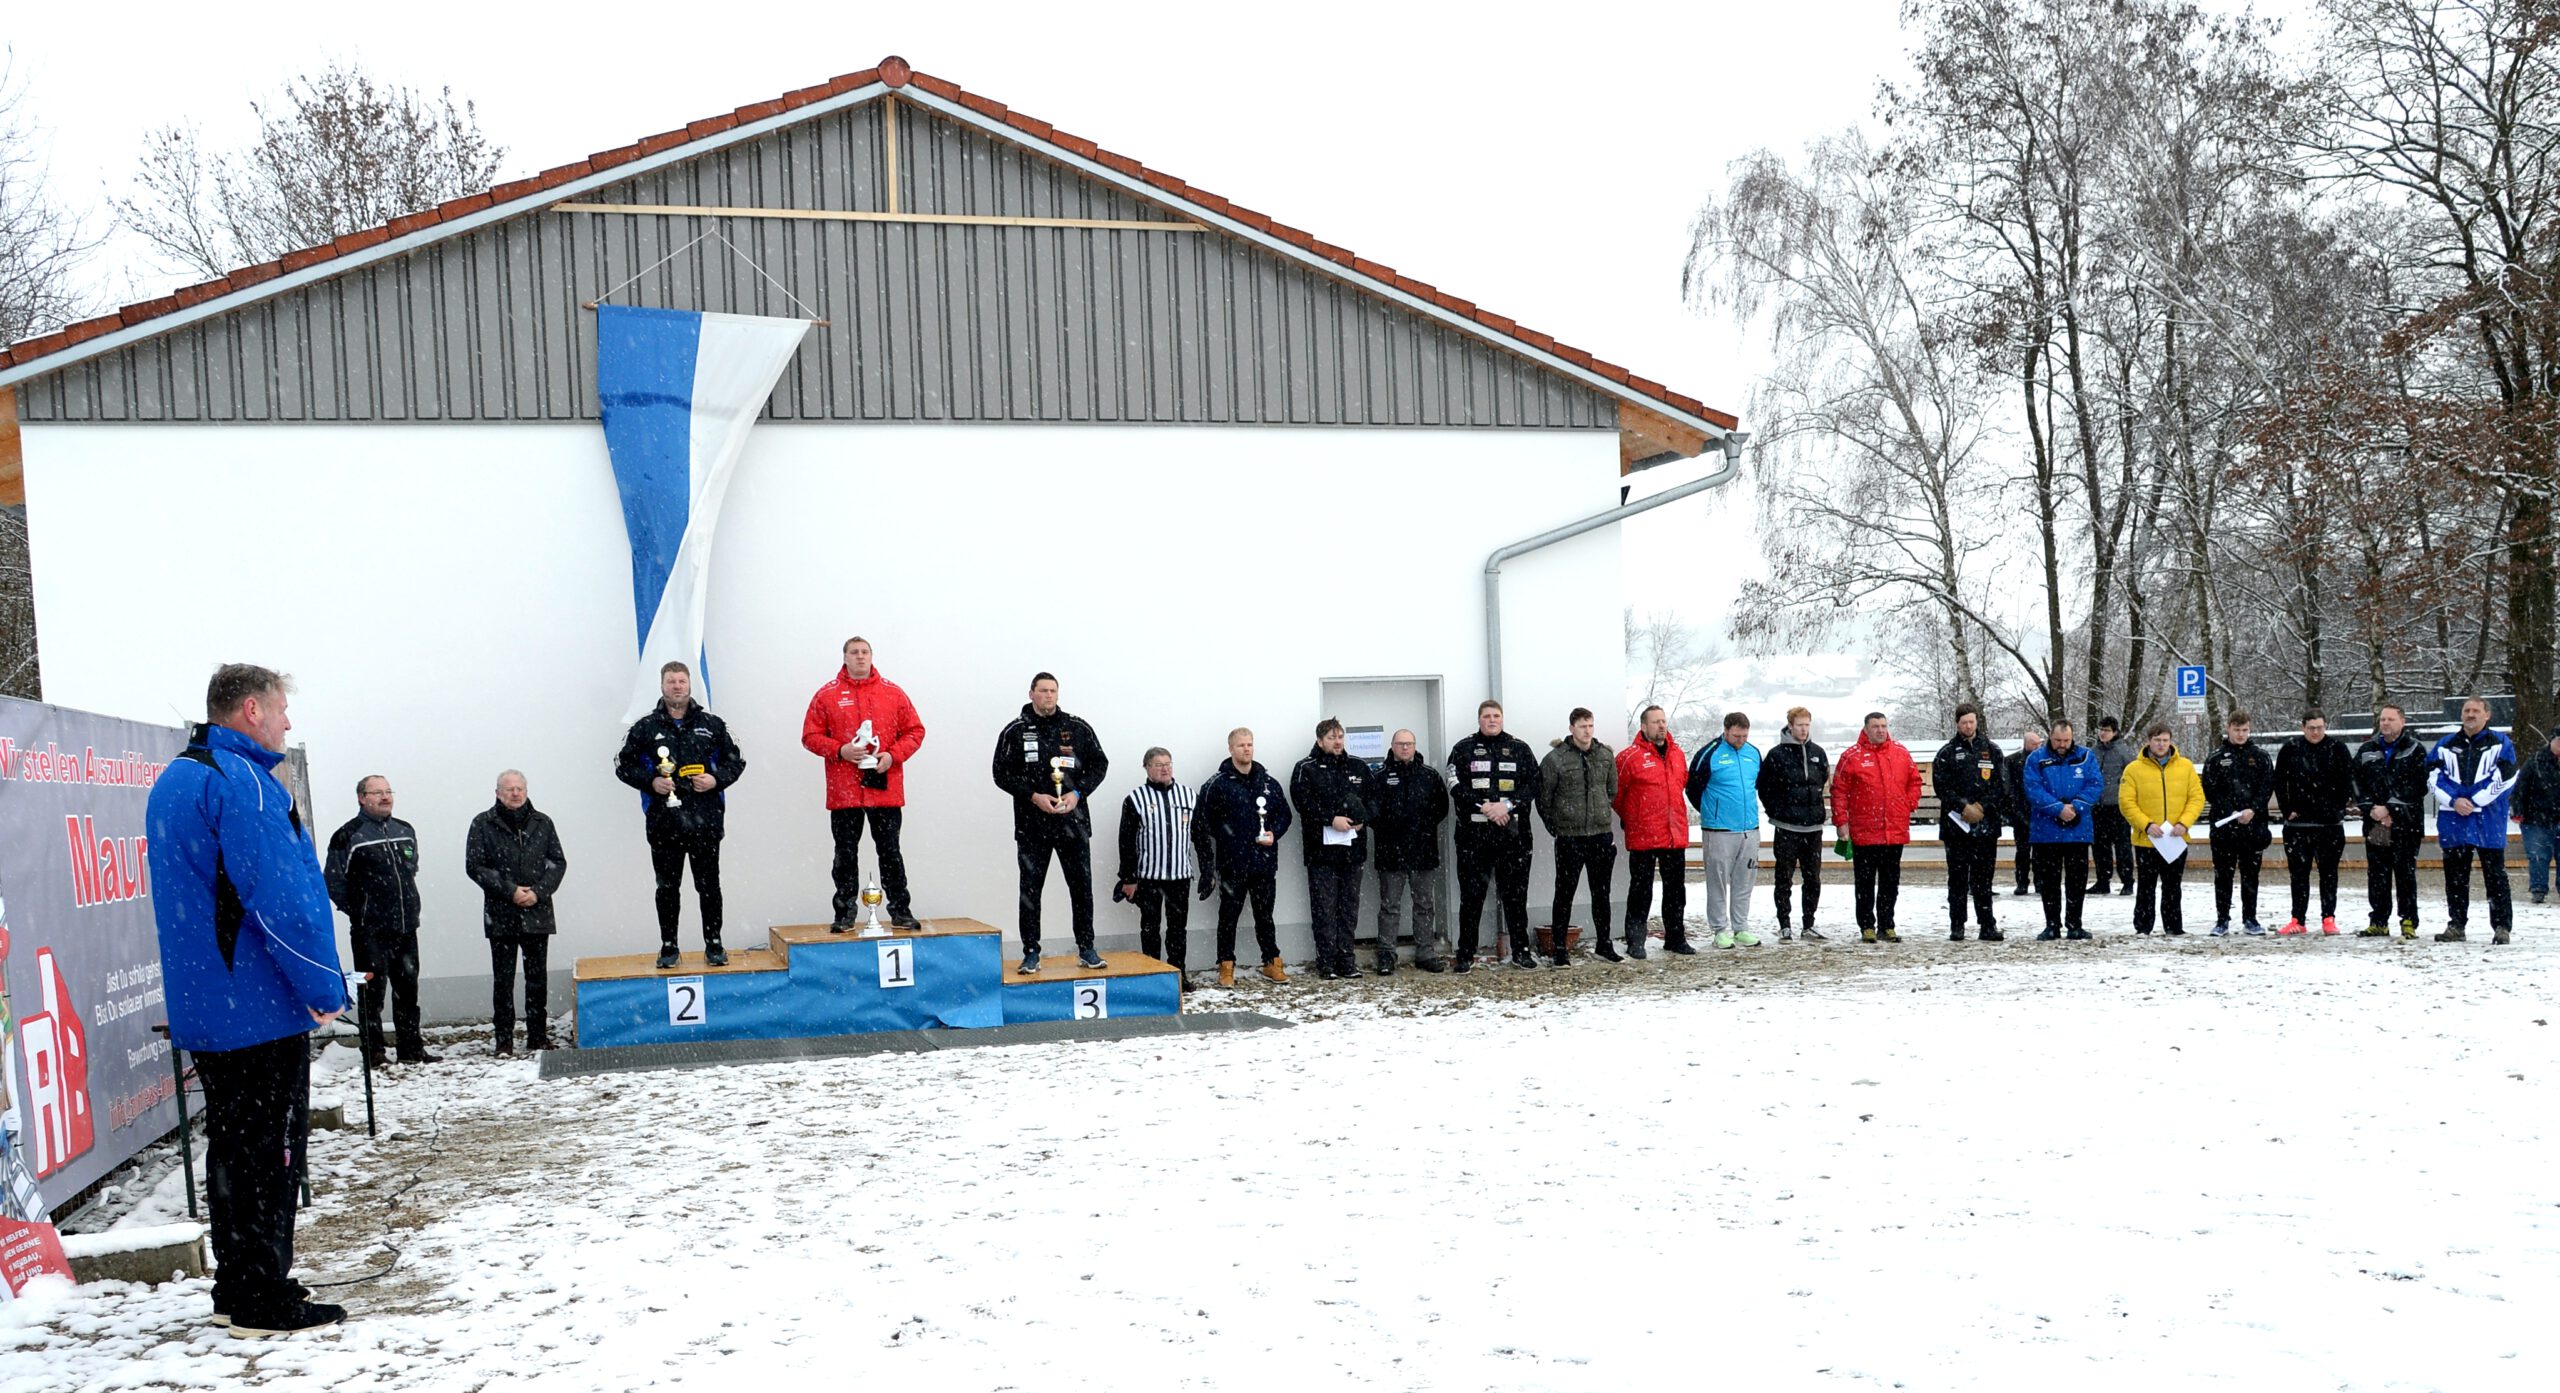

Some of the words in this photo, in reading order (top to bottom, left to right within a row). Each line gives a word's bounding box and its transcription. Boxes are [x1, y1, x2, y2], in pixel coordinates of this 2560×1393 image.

[2183, 669, 2199, 694] P
[23, 742, 81, 783] stellen
[886, 948, 907, 983] 1
[95, 1004, 108, 1026] Bist
[676, 986, 698, 1020] 2
[1080, 988, 1100, 1020] 3
[15, 1237, 41, 1254] GERNE
